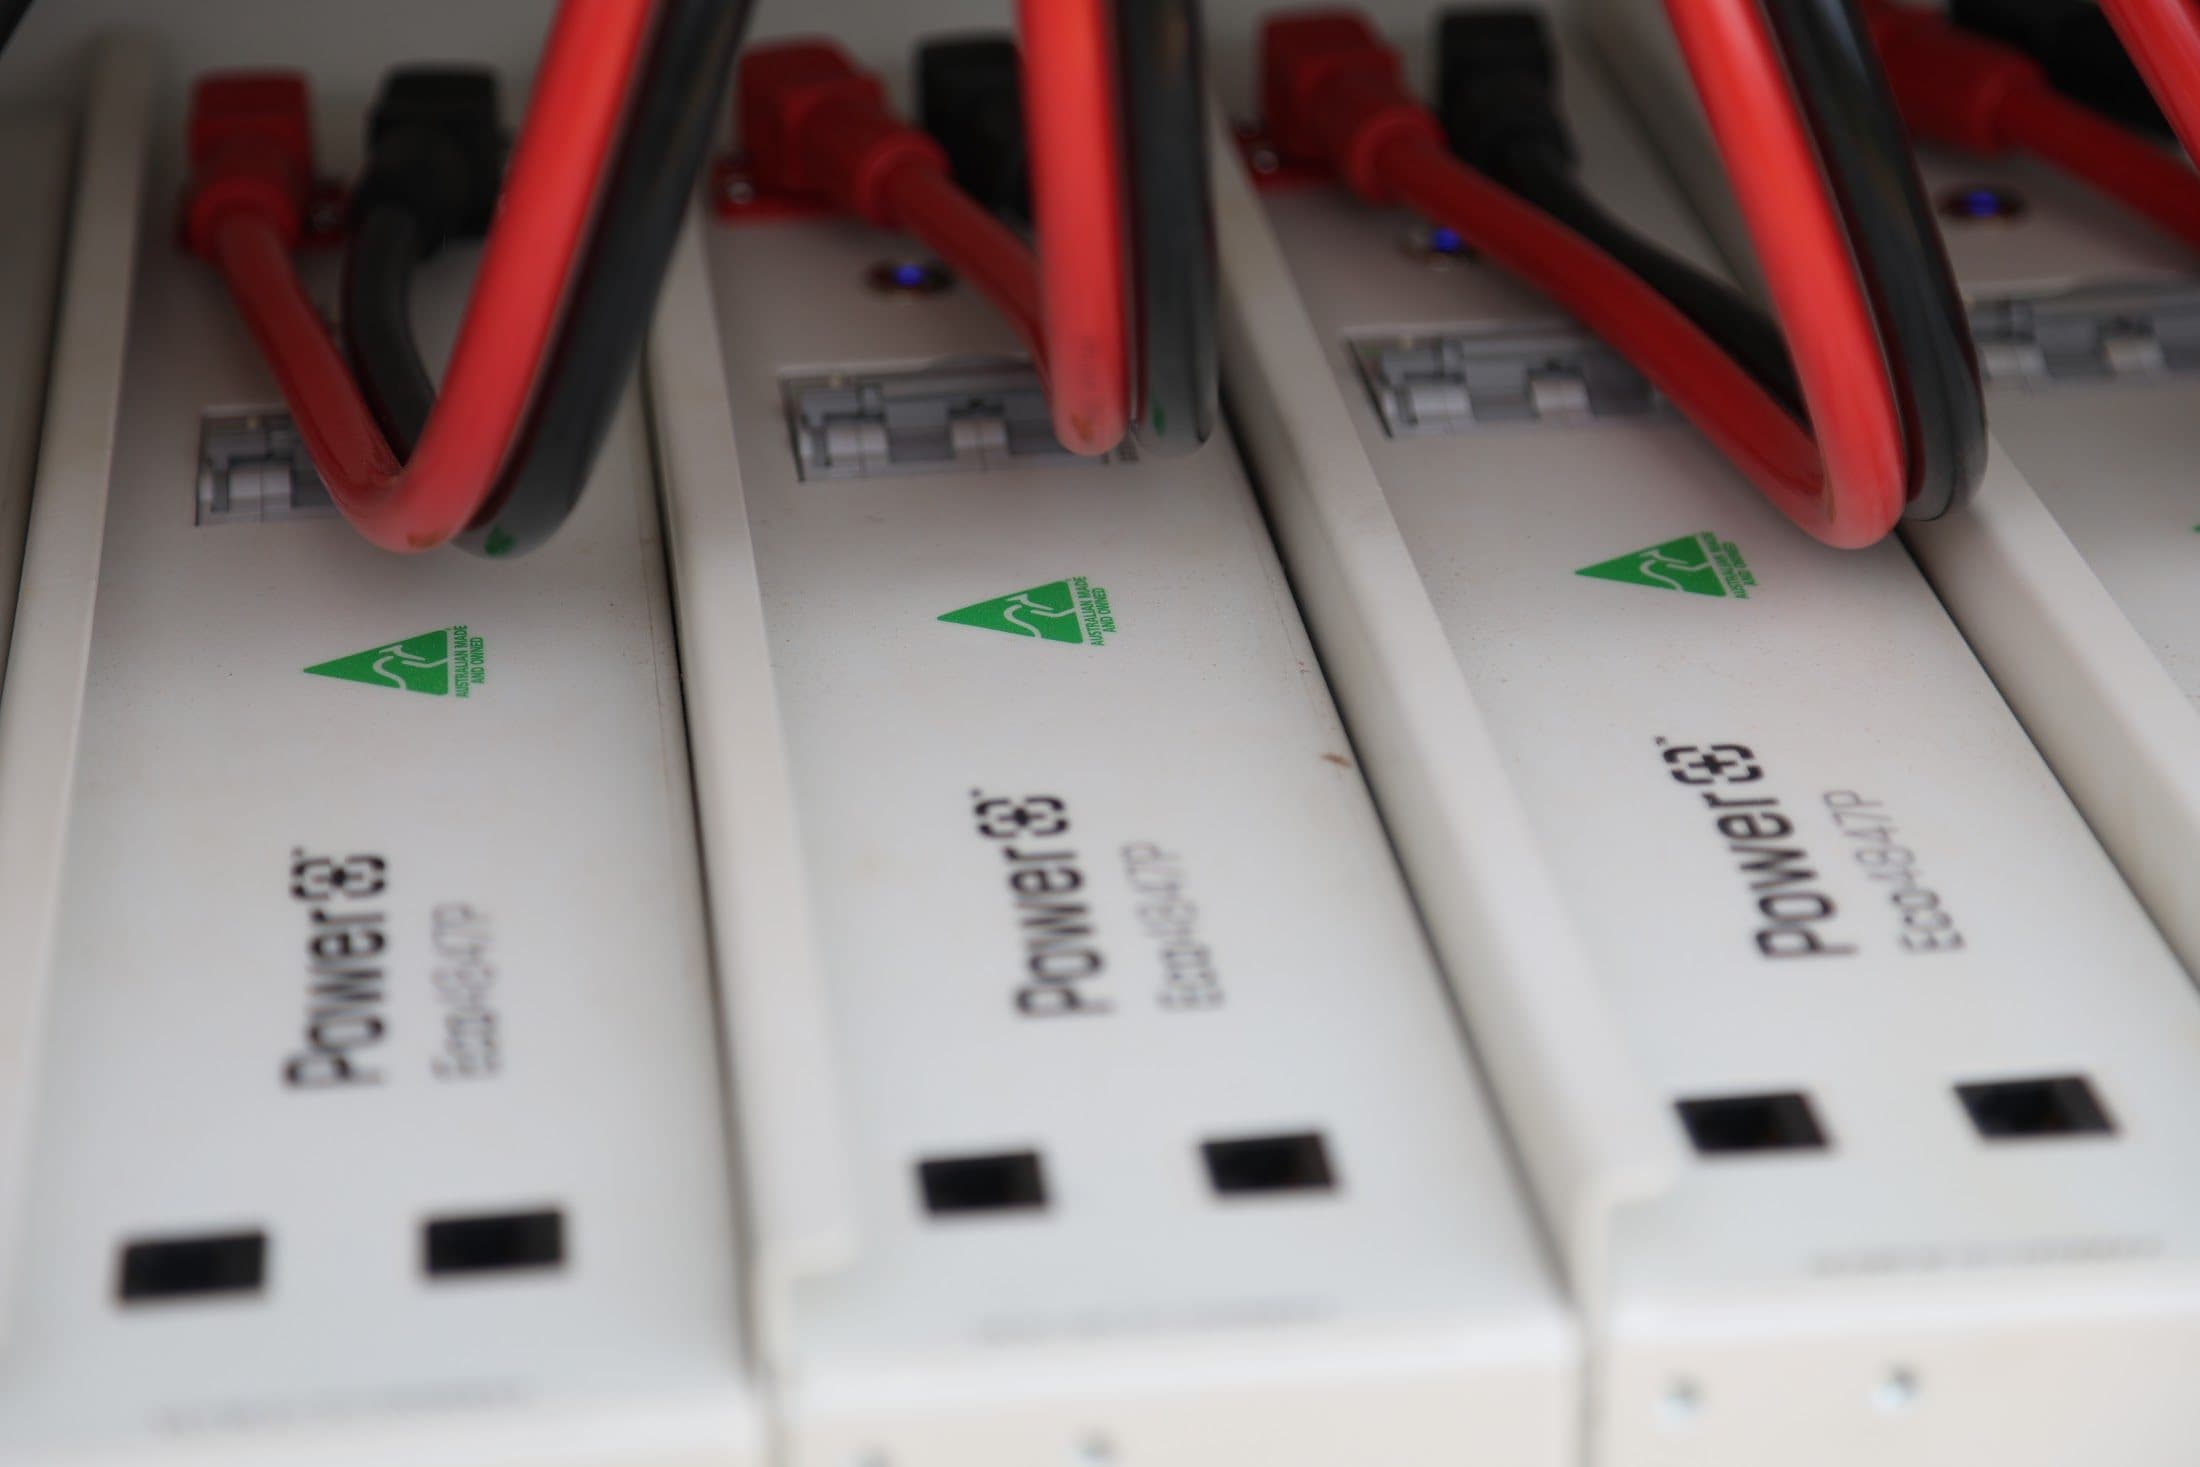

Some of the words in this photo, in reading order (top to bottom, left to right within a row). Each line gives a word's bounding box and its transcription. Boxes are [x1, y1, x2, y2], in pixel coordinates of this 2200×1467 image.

[1092, 588, 1111, 614] OWNED
[1080, 600, 1104, 646] AUSTRALIAN
[1100, 616, 1116, 632] AND
[454, 625, 468, 648] MADE
[470, 637, 484, 665] OWNED
[455, 650, 469, 697] AUSTRALIAN
[471, 666, 485, 684] AND
